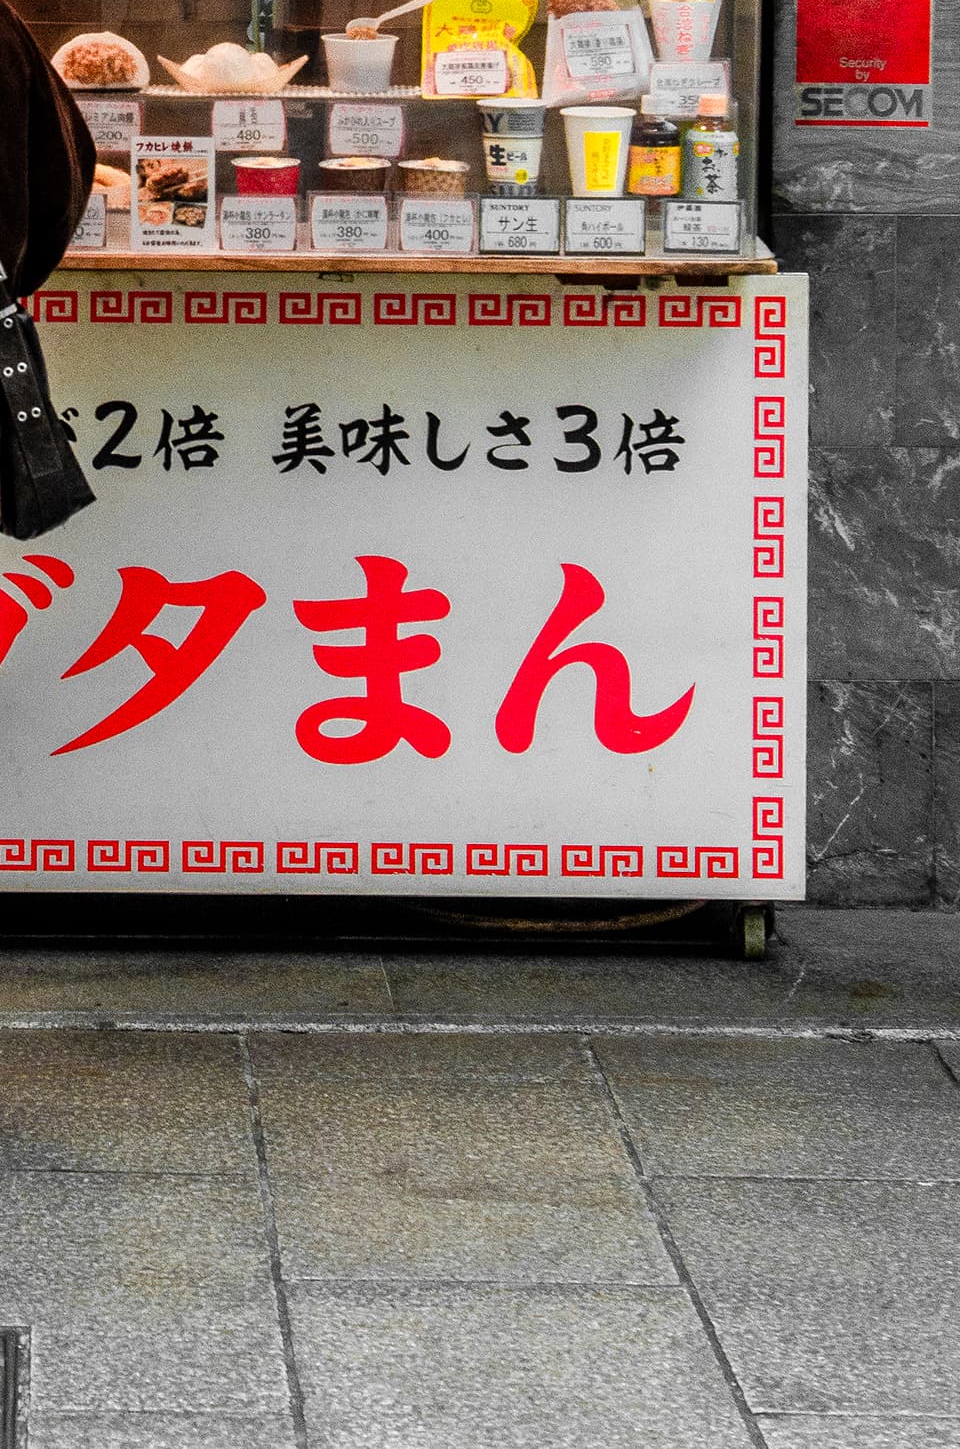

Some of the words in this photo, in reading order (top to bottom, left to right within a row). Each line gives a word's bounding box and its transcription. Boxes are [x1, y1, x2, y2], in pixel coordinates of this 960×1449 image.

[840, 57, 887, 71] Security
[461, 75, 484, 85] 450
[855, 69, 870, 82] by
[801, 87, 924, 117] SECOM
[497, 216, 539, 232] サン生
[245, 227, 271, 240] 380
[336, 227, 362, 239] 380
[424, 229, 449, 241] 400
[270, 402, 688, 476] 美味しさ3倍
